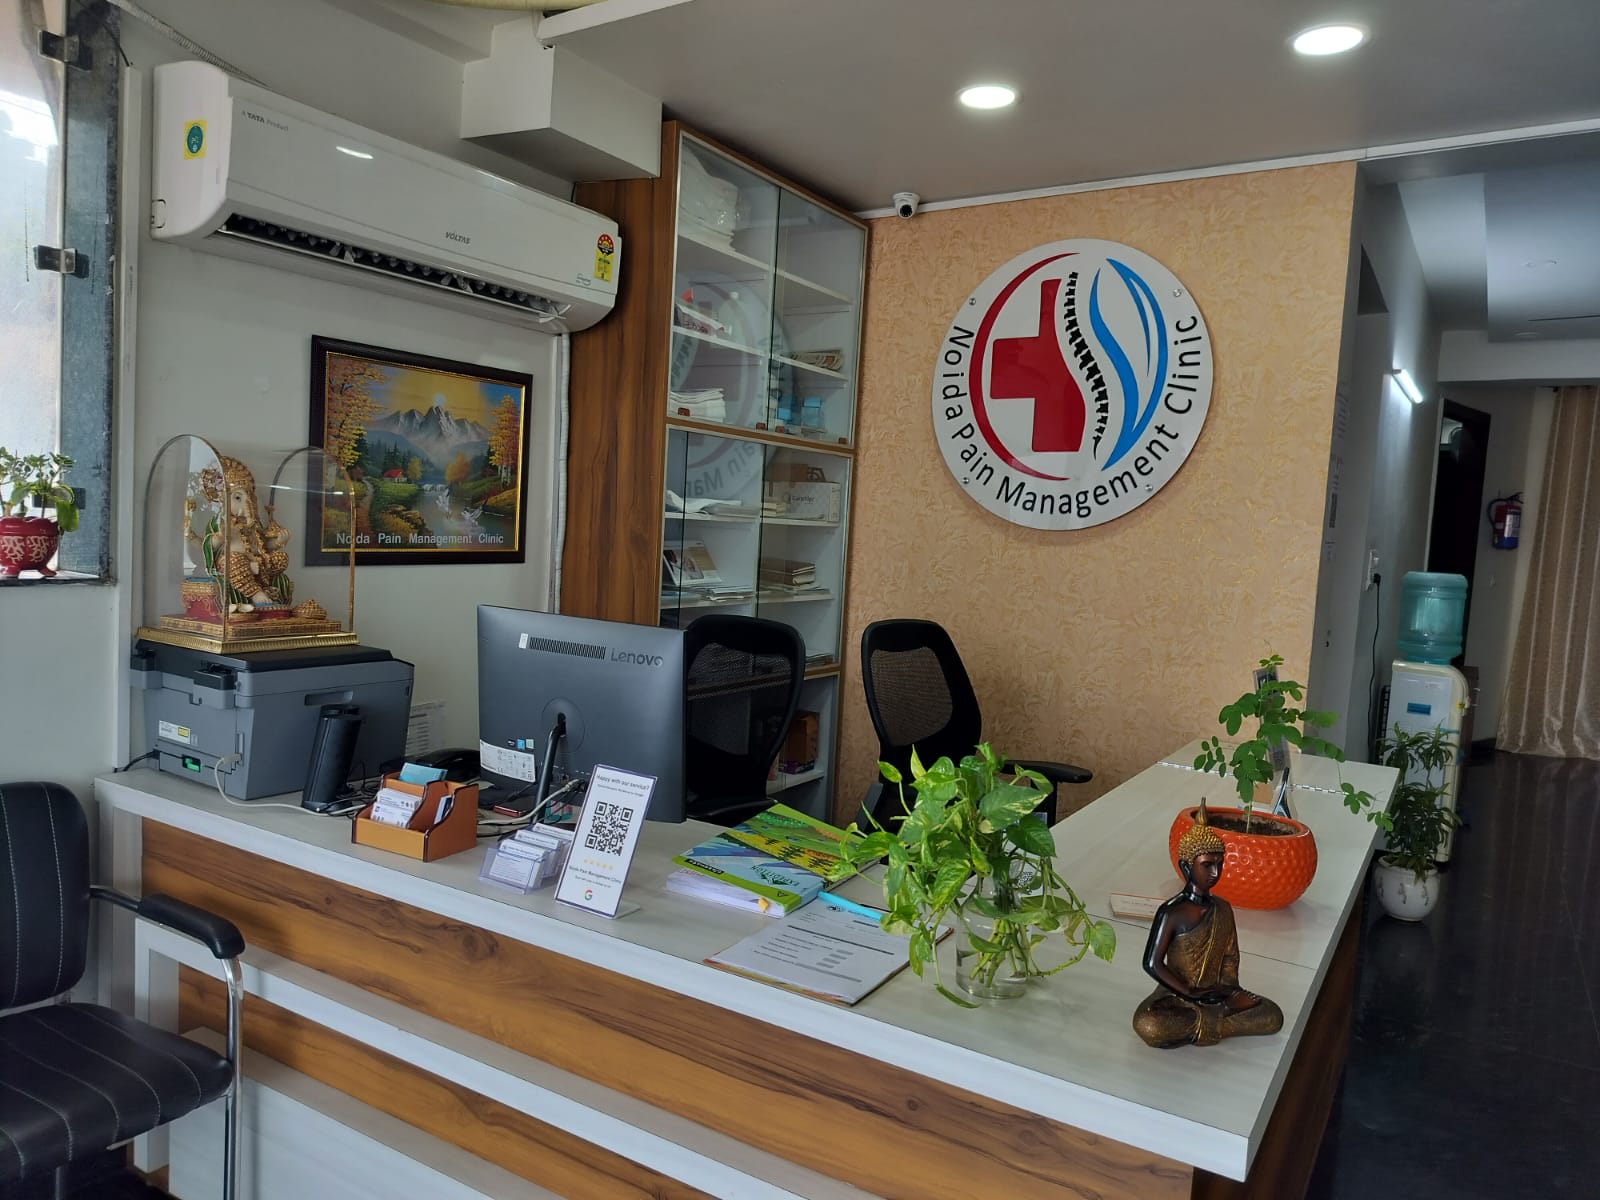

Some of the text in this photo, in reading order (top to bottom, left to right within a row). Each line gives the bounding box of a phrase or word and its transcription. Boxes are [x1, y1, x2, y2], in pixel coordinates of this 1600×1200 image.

[942, 315, 1202, 518] Noida Pain Management Clinic
[336, 532, 504, 545] Noda Pain Management Clinic
[611, 647, 664, 666] Lenovo
